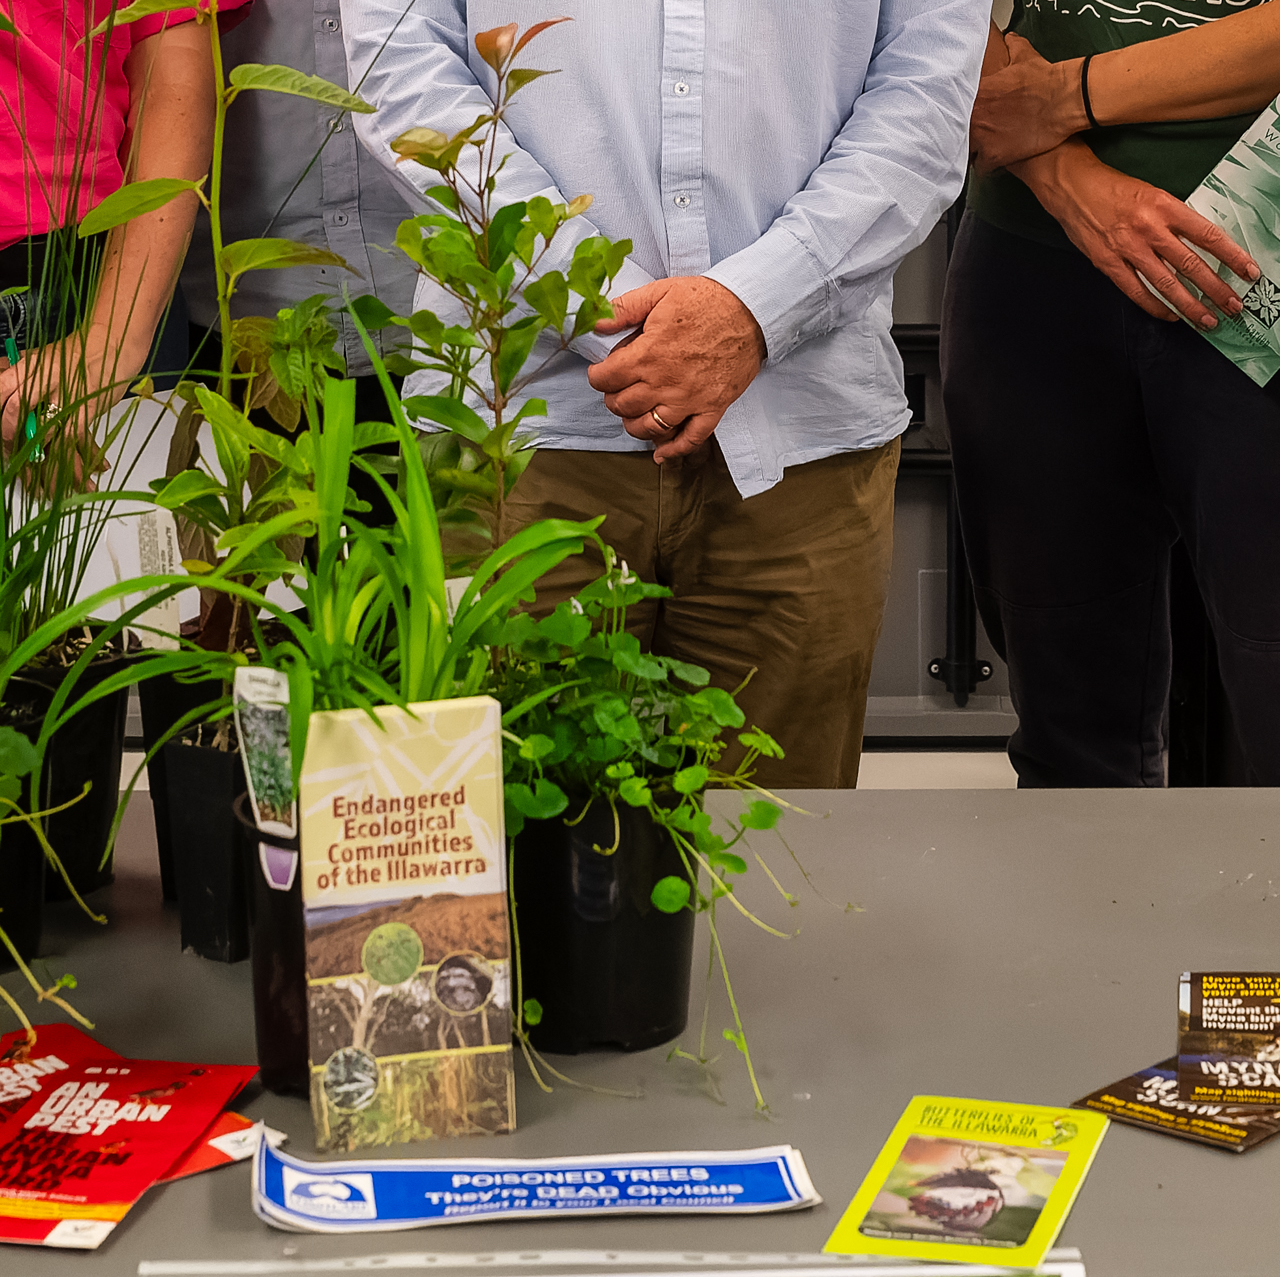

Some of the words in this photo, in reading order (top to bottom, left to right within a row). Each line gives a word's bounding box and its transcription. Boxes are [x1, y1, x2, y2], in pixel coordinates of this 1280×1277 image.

[332, 784, 467, 820] Endangered
[343, 808, 457, 841] Ecological
[327, 832, 474, 864] Communities
[316, 870, 341, 891] of
[345, 863, 382, 885] the
[386, 856, 488, 881] Illawarra
[1202, 998, 1243, 1007] HELP
[55, 1081, 110, 1100] AN
[39, 1096, 172, 1122] URBAN
[922, 1104, 1014, 1124] BUTTERFLIES
[1019, 1115, 1036, 1126] OF
[23, 1112, 120, 1136] PEST
[919, 1115, 944, 1127] THE
[951, 1118, 1039, 1138] ILLAWARRA
[450, 1169, 606, 1188] POISONED
[611, 1167, 710, 1183] TREES
[424, 1186, 529, 1206] They're
[535, 1184, 620, 1199] DEAD
[626, 1183, 745, 1197] Obvious
